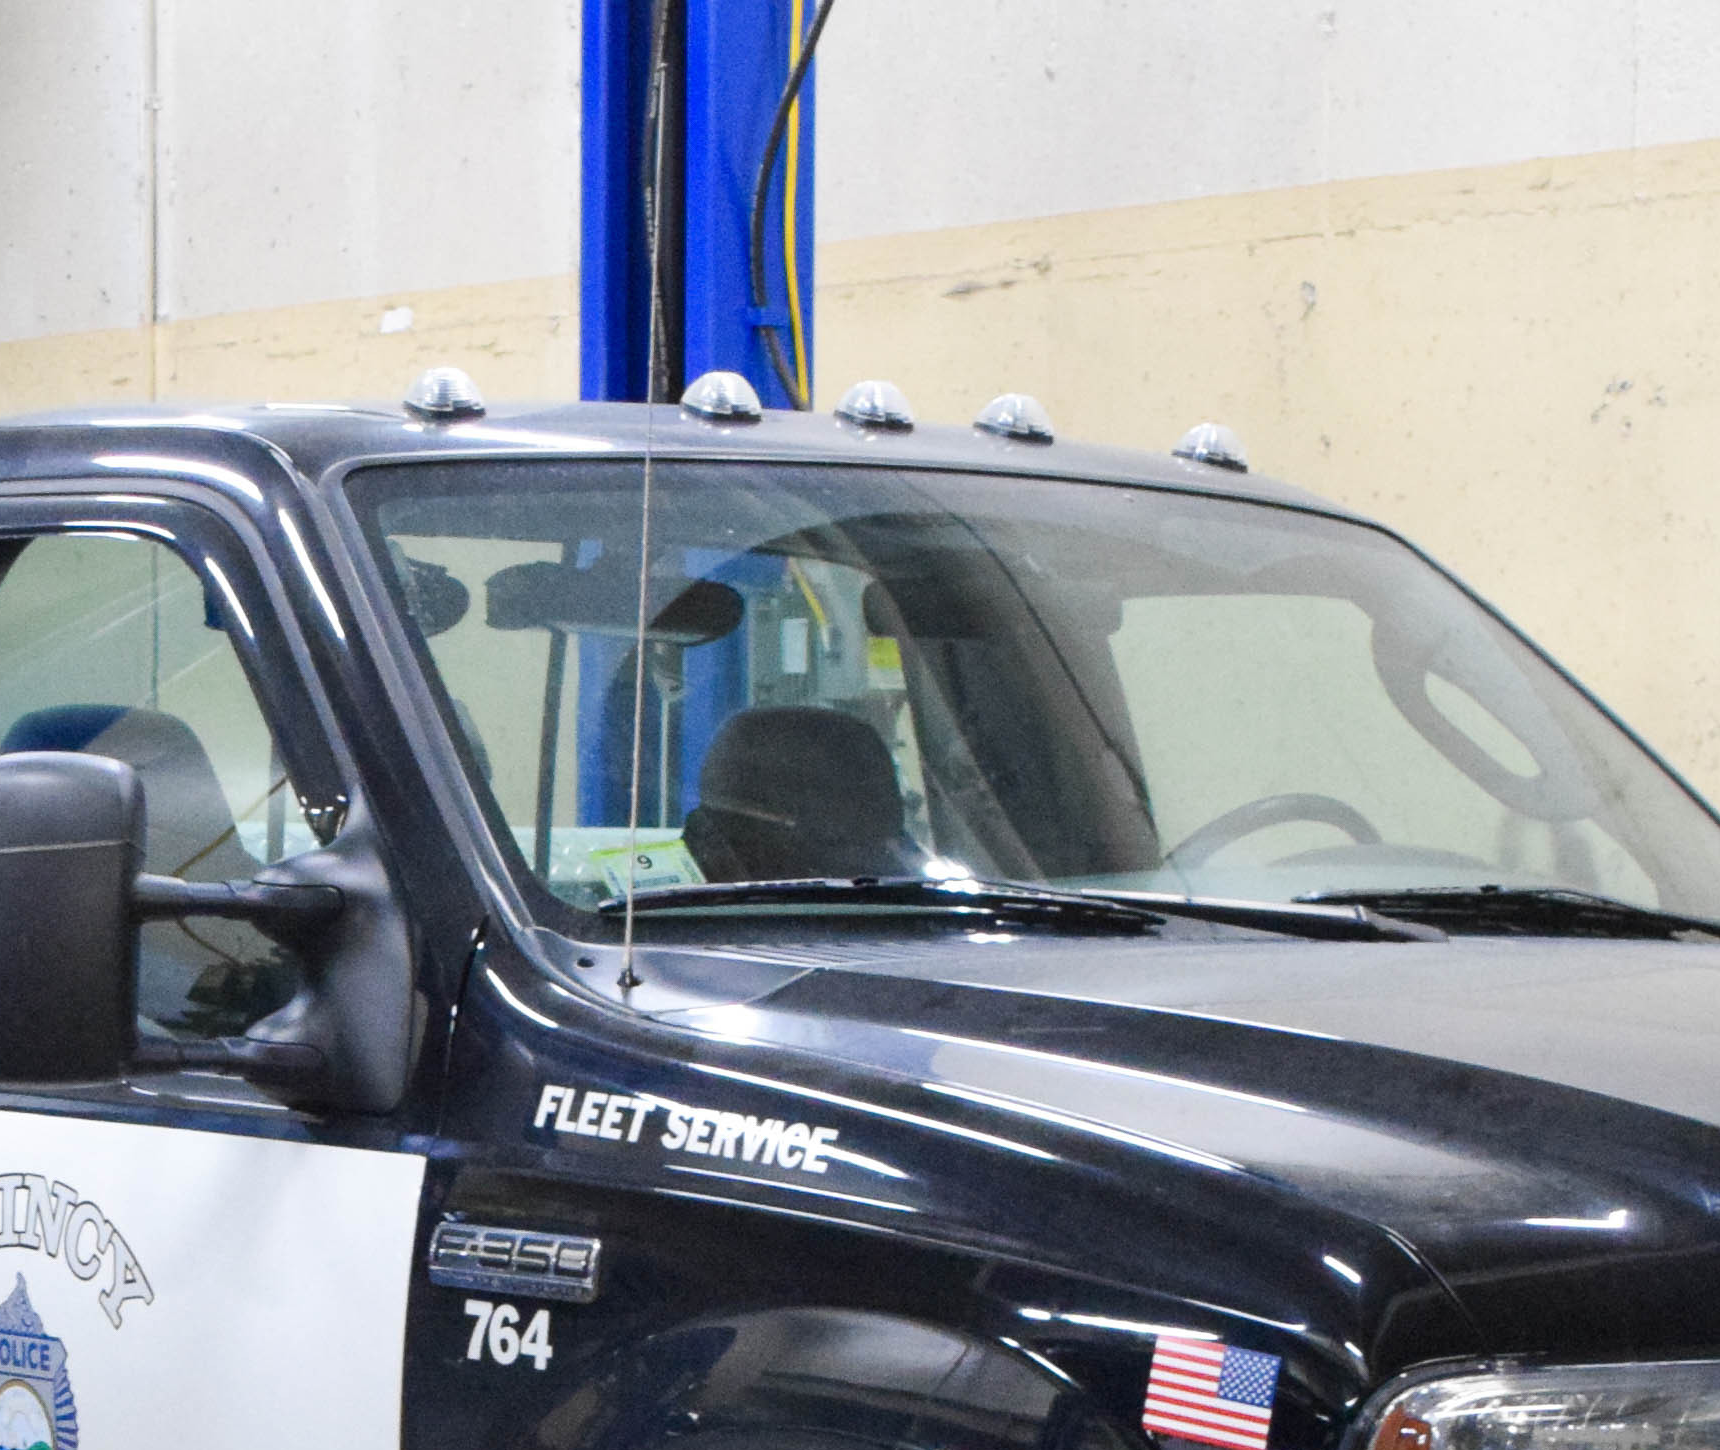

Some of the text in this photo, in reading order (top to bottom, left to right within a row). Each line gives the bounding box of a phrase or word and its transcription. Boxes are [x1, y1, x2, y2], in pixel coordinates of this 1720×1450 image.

[533, 1084, 839, 1174] FLEET SERVICE
[464, 1299, 554, 1371] 764
